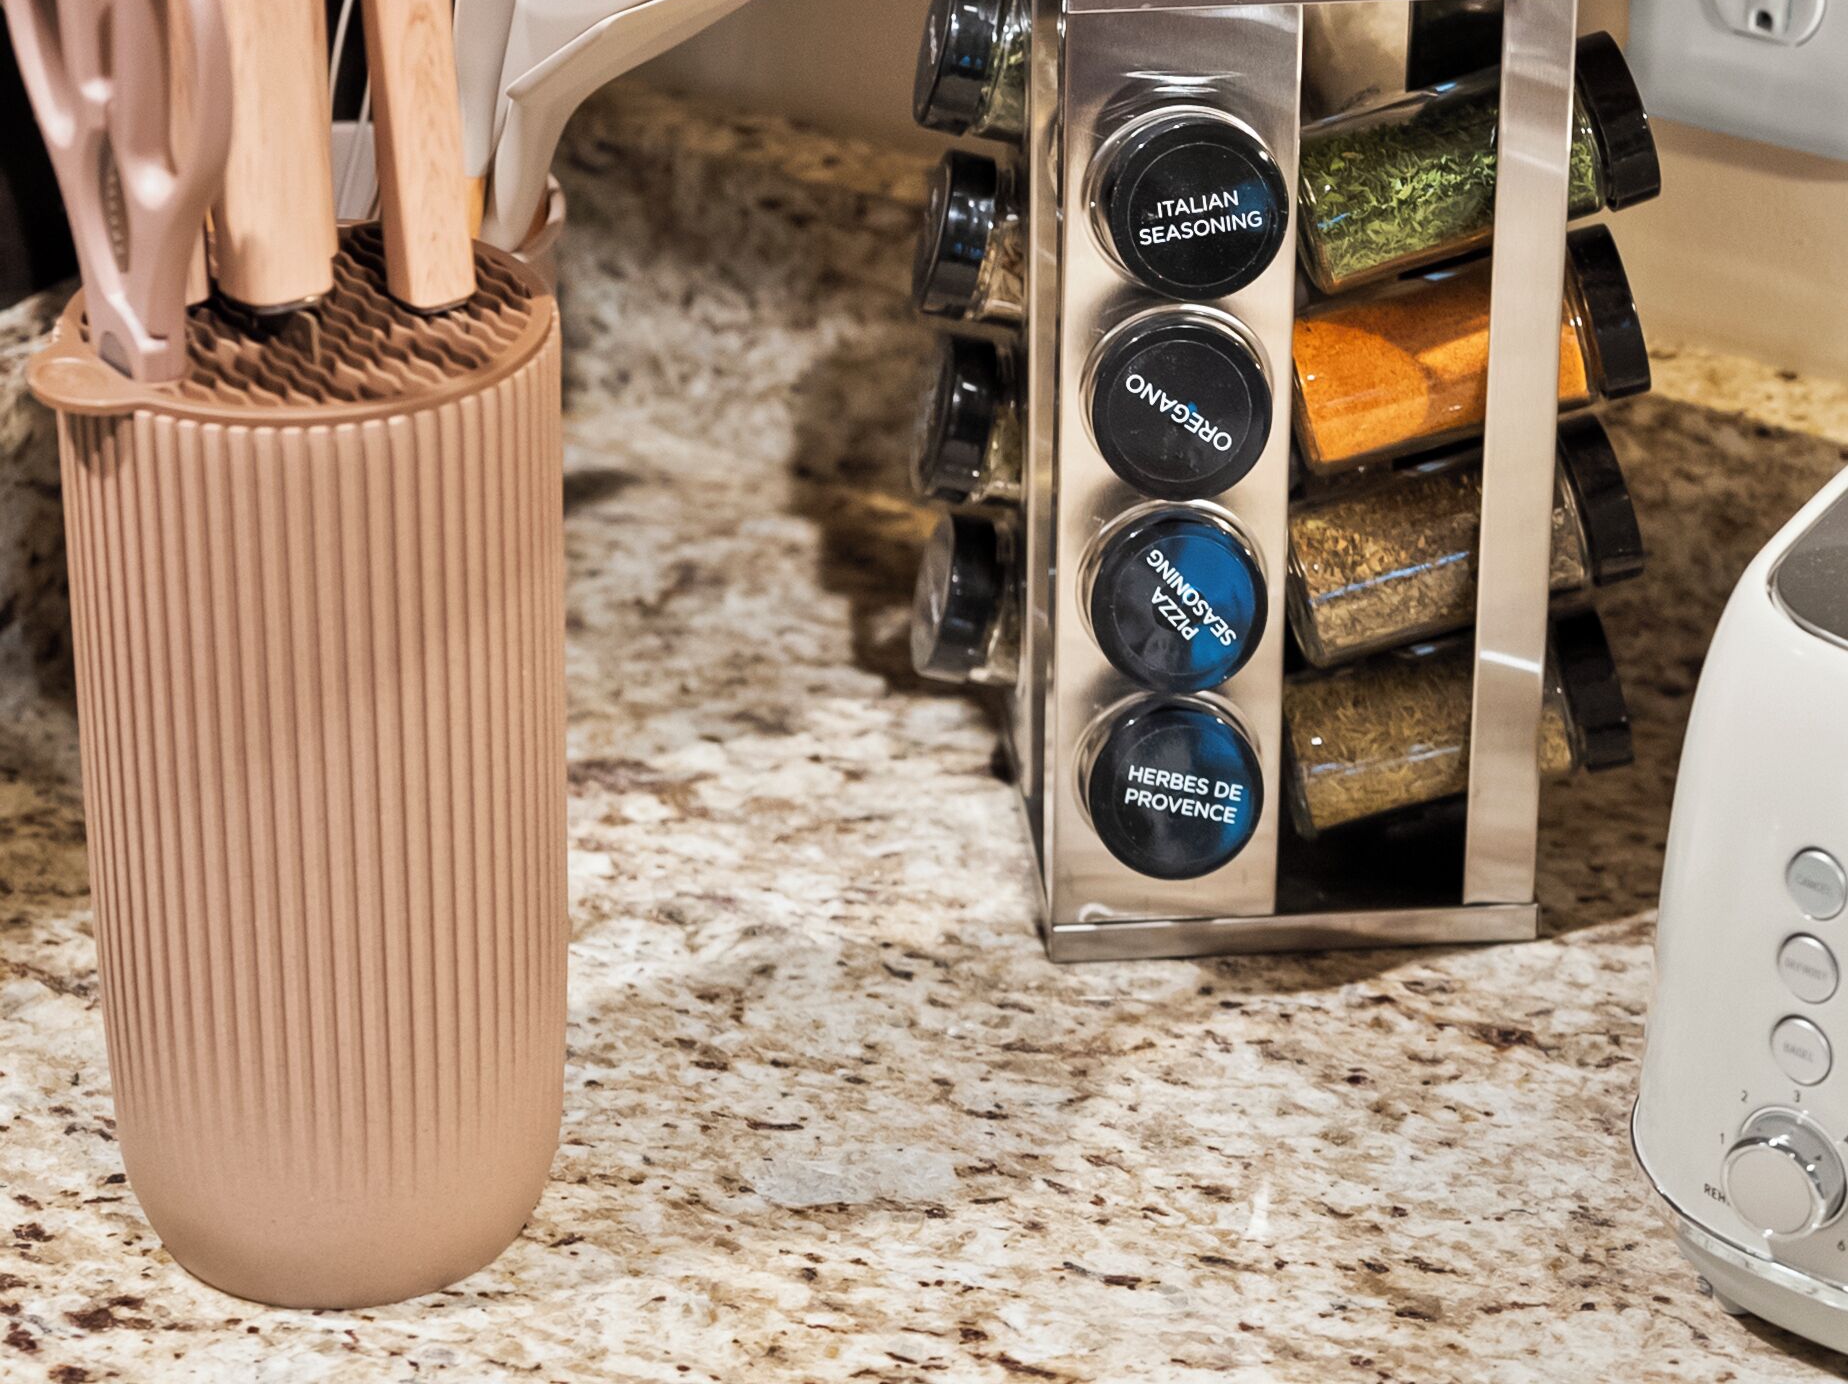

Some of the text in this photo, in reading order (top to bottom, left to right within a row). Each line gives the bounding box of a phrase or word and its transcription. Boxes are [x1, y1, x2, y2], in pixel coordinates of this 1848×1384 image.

[1157, 189, 1239, 218] ITALIAN
[1139, 210, 1263, 246] SEASONING
[1125, 373, 1232, 452] OREGANO
[1146, 549, 1237, 646] SEASONING
[1151, 585, 1200, 641] PIZZA
[1128, 764, 1244, 802] HERBES DE
[1124, 787, 1238, 825] PROVENCE
[1740, 1089, 1801, 1103] 2 3
[1720, 1132, 1725, 1145] 1
[1703, 1182, 1730, 1206] REH
[1837, 1239, 1846, 1253] 6
